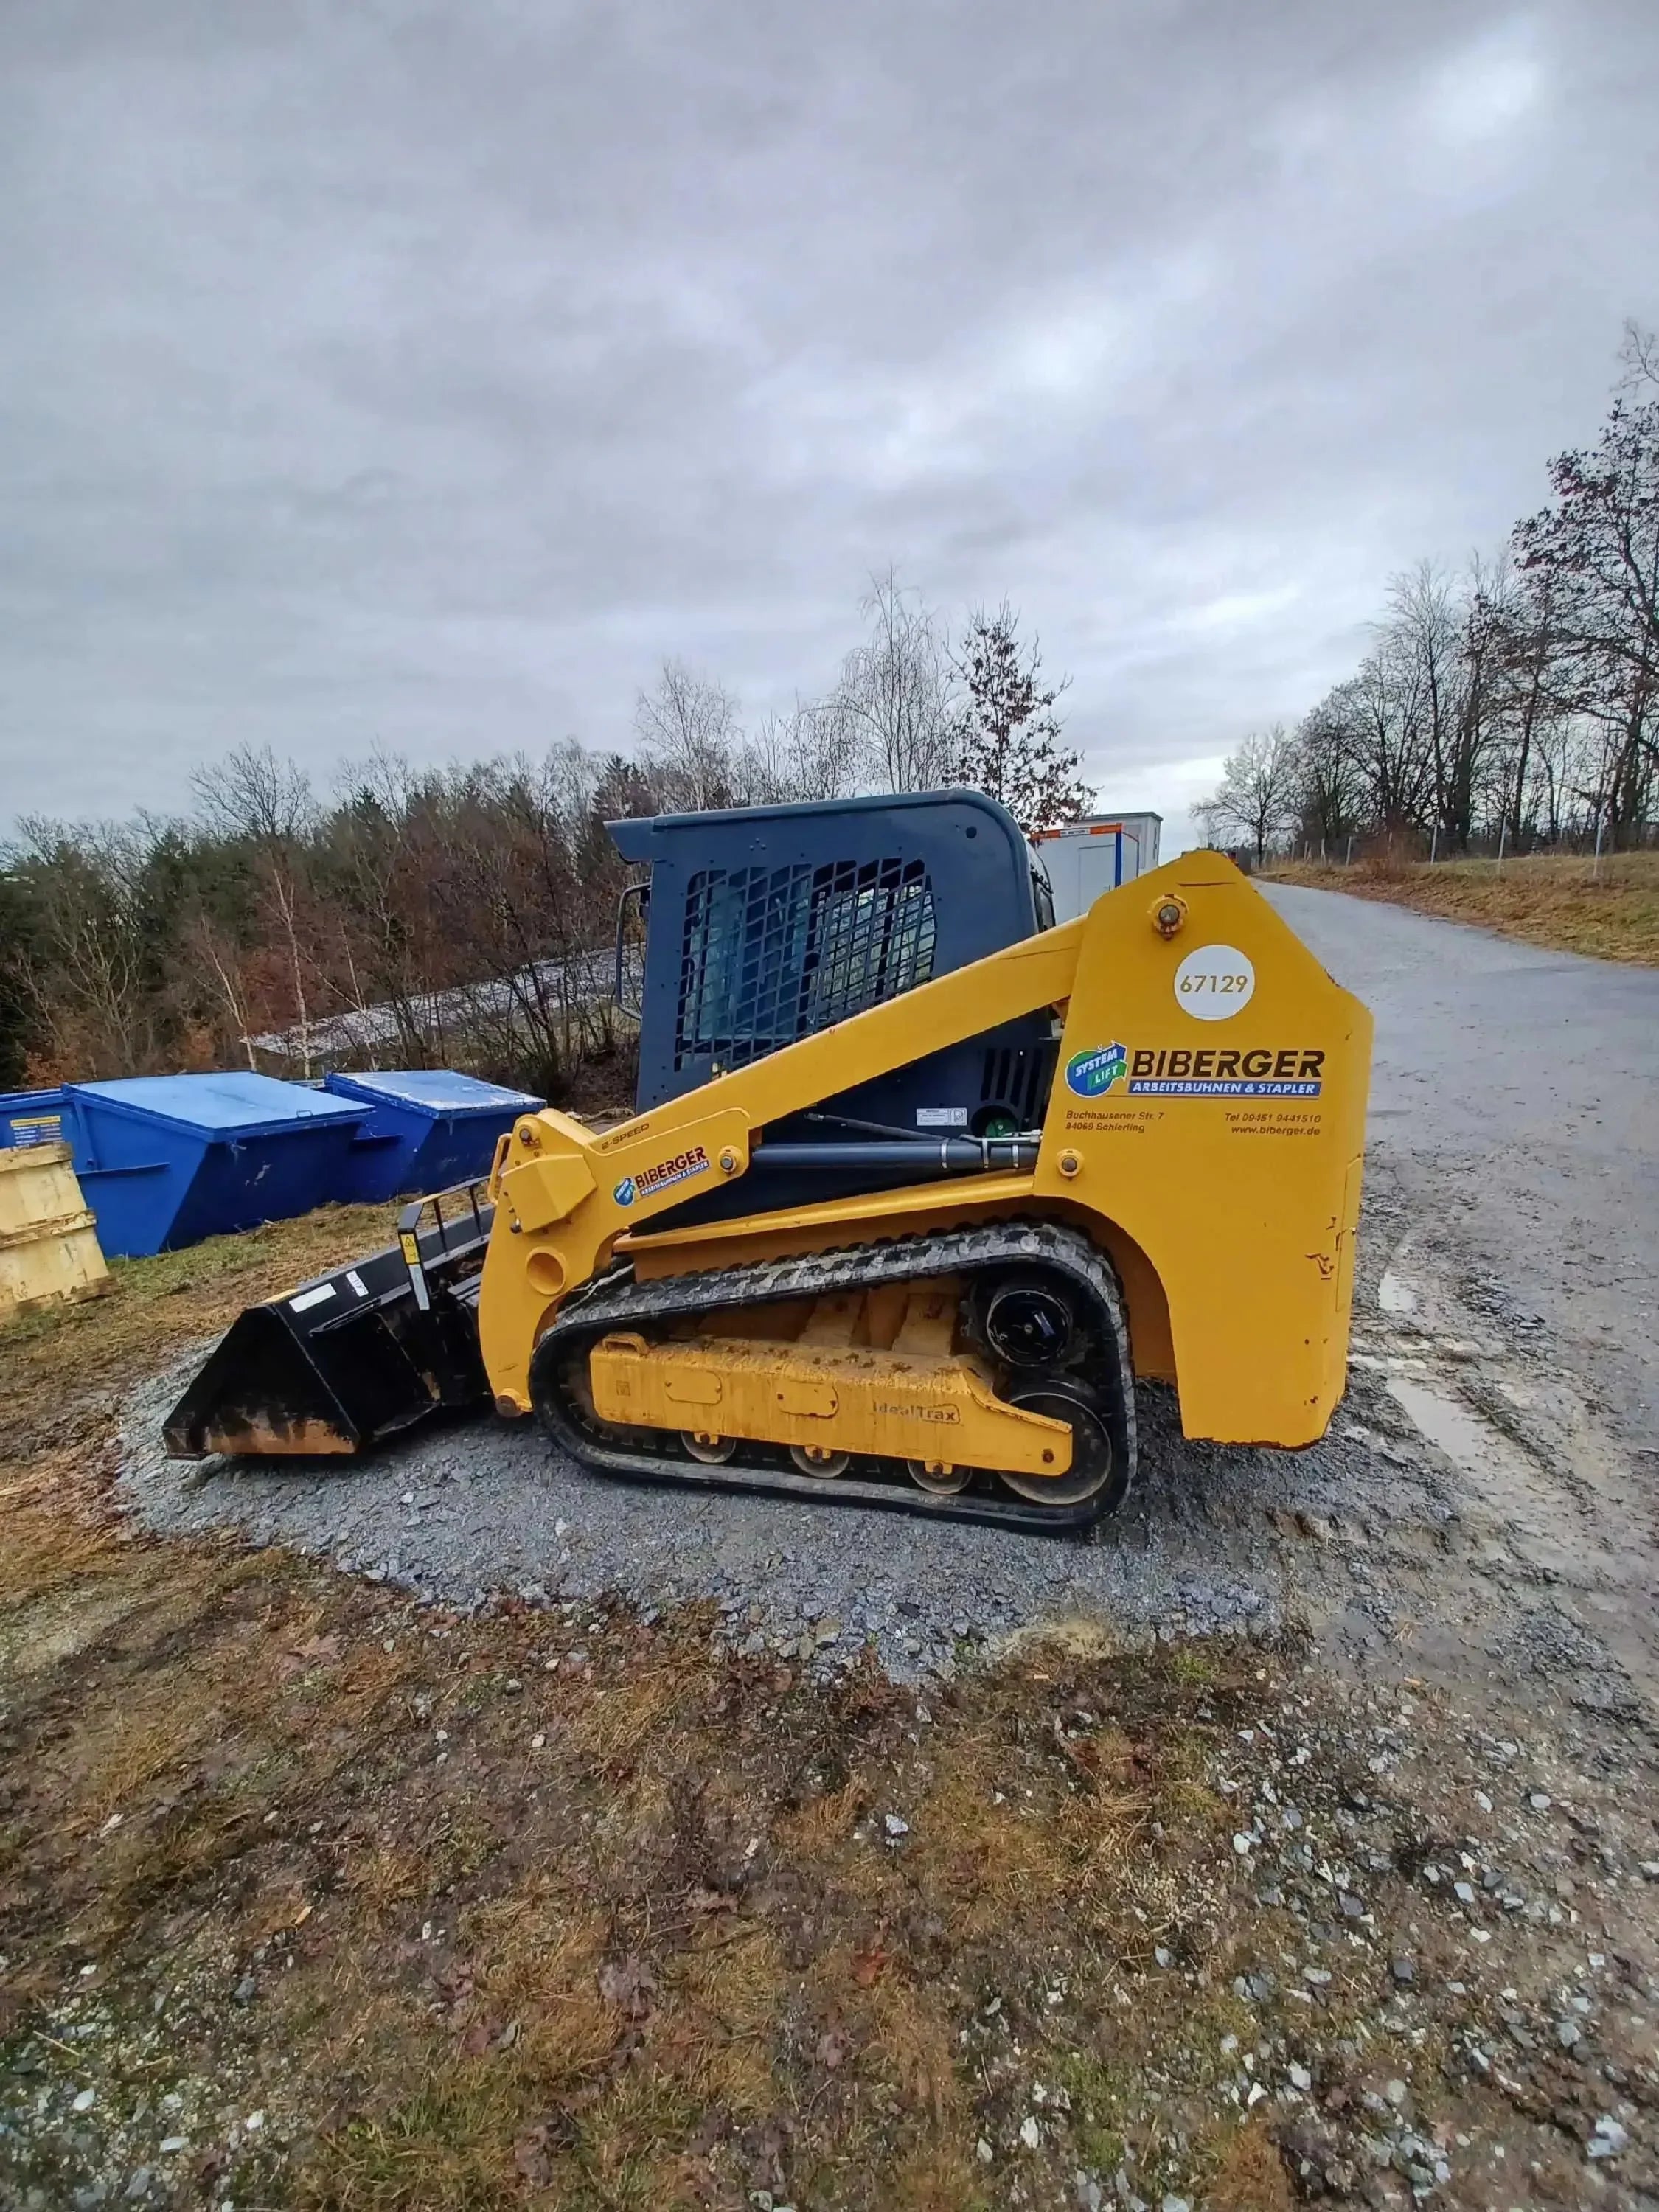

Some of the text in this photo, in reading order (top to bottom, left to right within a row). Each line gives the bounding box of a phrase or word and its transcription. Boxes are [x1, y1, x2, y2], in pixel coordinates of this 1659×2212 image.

[1180, 975, 1248, 992] 67129
[1074, 1049, 1118, 1077] SYSTEM
[1131, 1050, 1325, 1077] BIBERGER
[1095, 1065, 1119, 1084] LIFT
[1244, 1083, 1255, 1093] &
[1257, 1084, 1315, 1093] STAPLER
[1066, 1110, 1135, 1119] Buchhausener
[1138, 1112, 1154, 1120] Str.
[1225, 1113, 1321, 1123] Tel 09451 9441510
[1096, 1123, 1144, 1133] Schierling
[1231, 1126, 1321, 1136] www.biberger.de
[635, 1146, 707, 1189] BIBERGER
